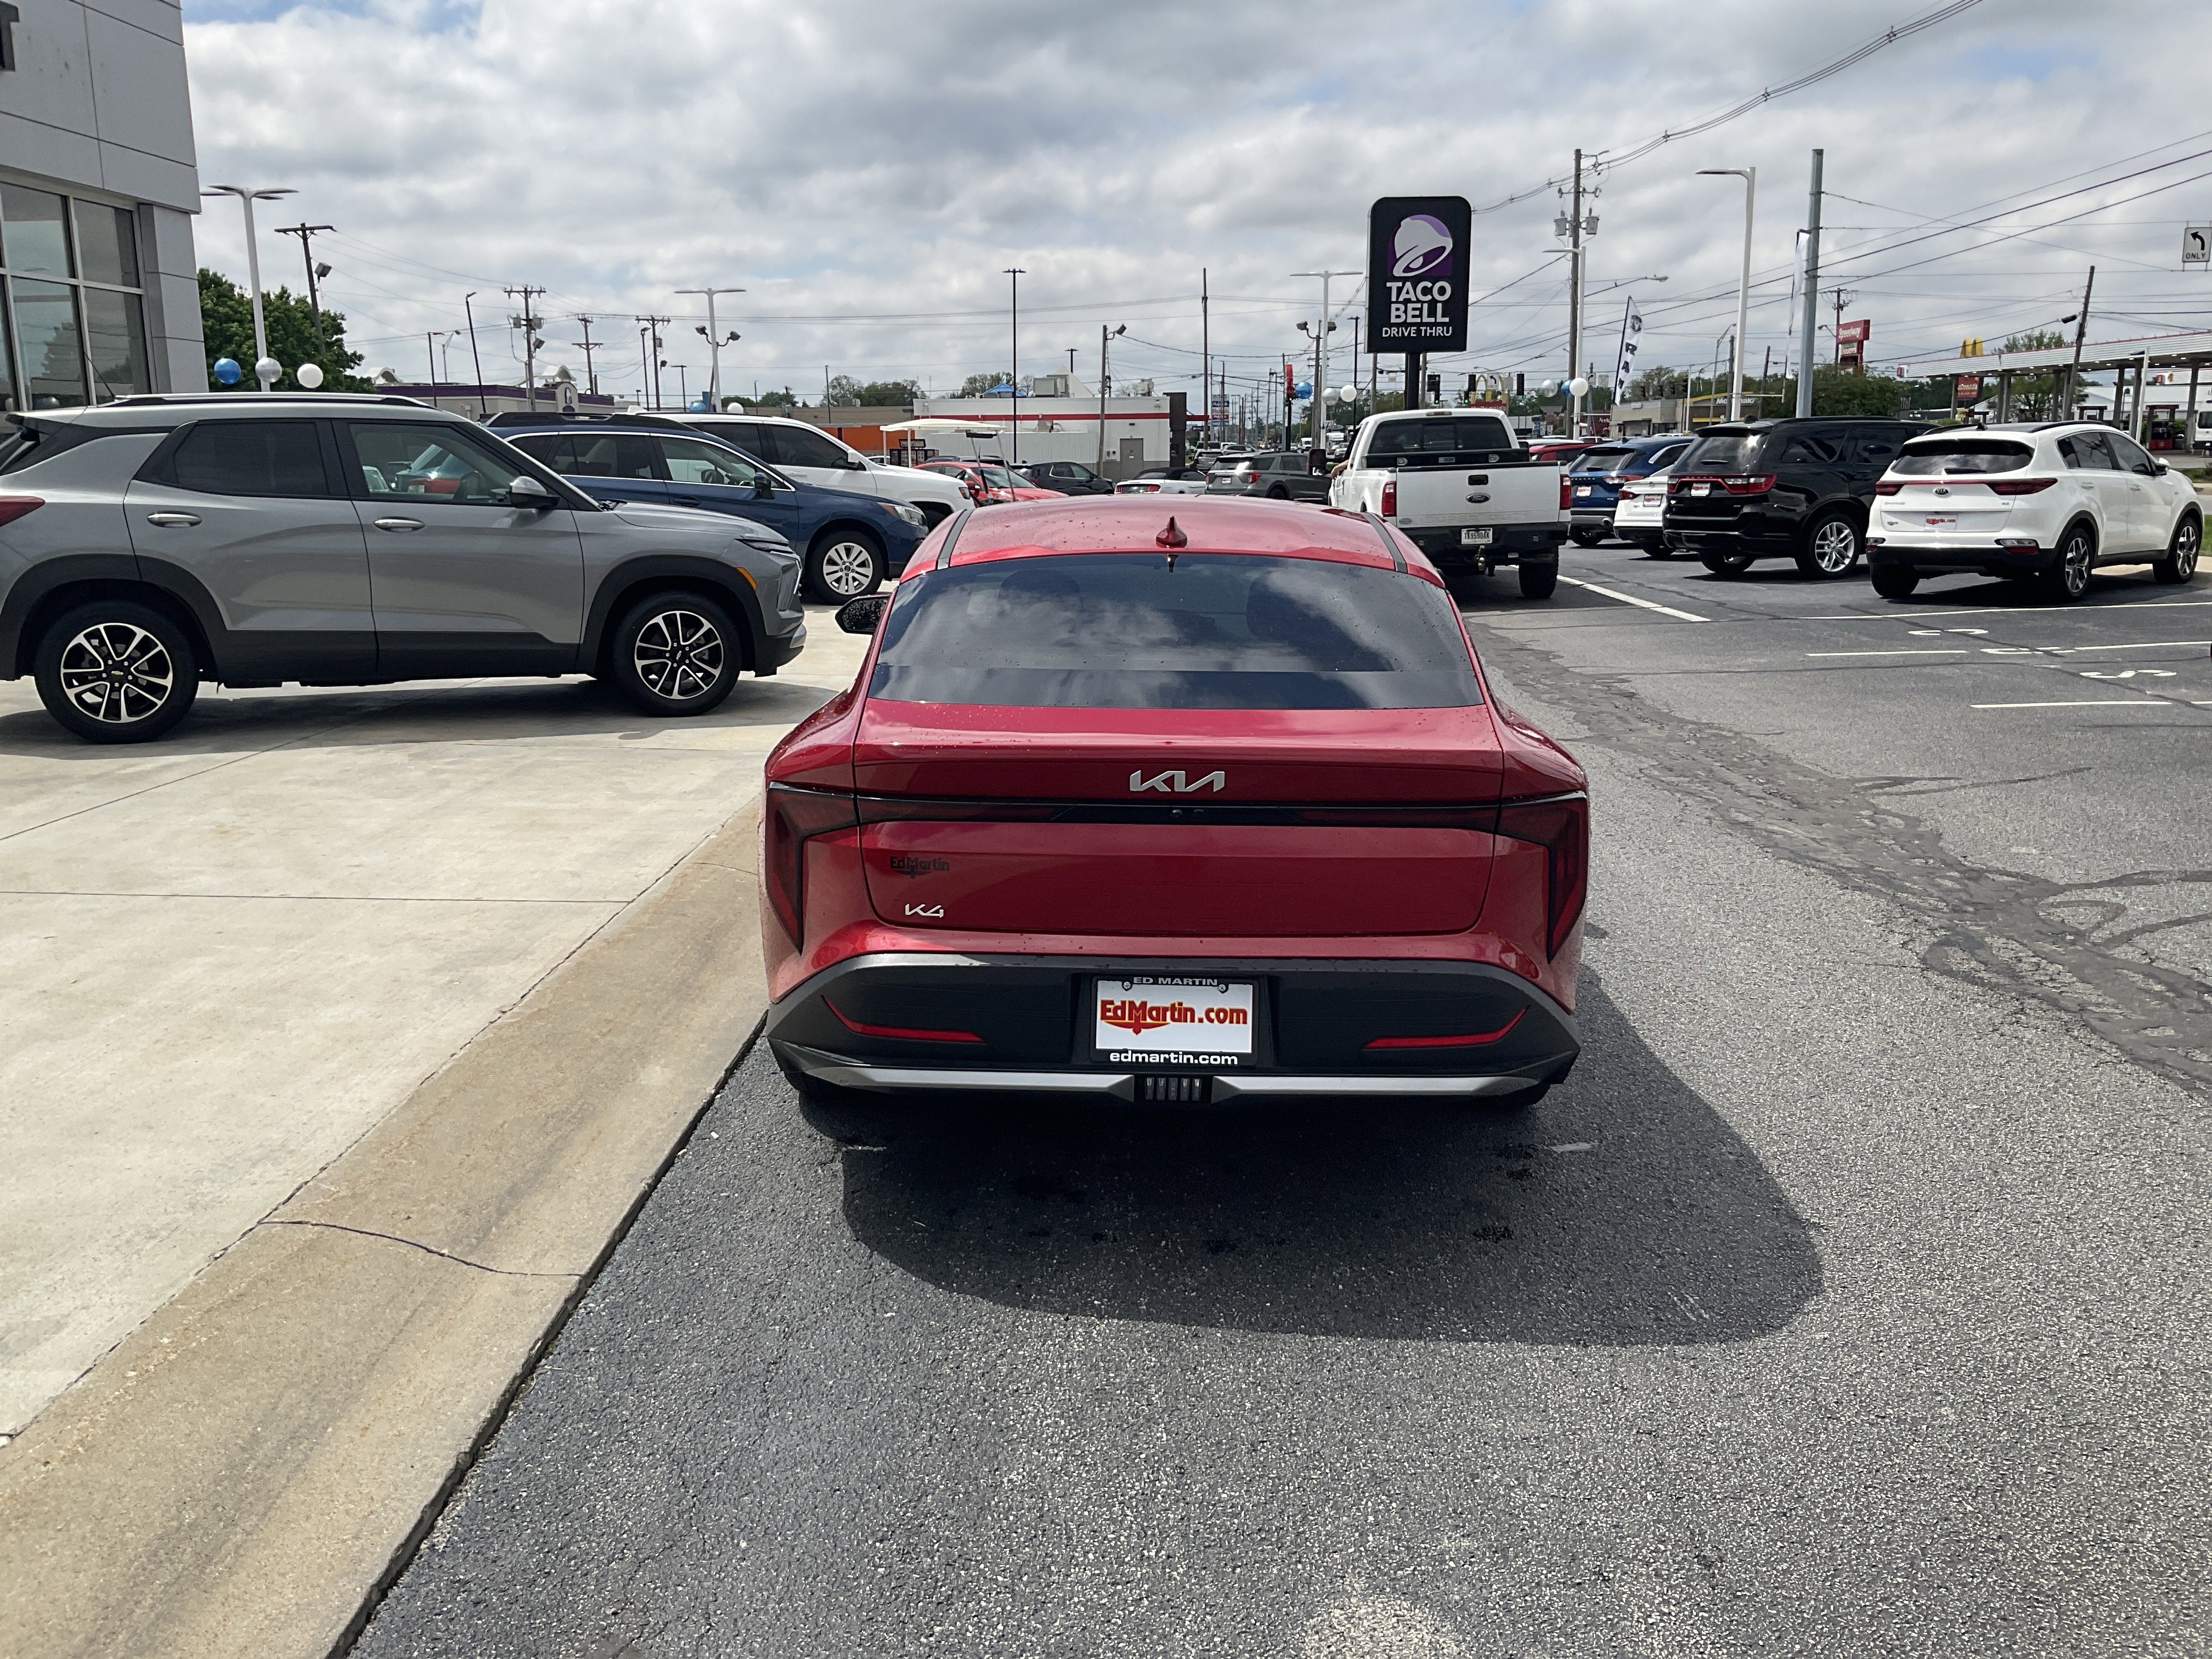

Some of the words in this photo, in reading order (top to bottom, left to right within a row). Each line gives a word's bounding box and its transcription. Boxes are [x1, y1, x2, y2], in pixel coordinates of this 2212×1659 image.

[1386, 281, 1451, 301] TACO
[1391, 303, 1449, 323] BELL
[1383, 327, 1417, 337] DRIVE
[1420, 326, 1452, 336] THRU
[1838, 326, 1861, 341] Speedway
[1130, 770, 1224, 792] KIA
[890, 856, 949, 872] EdMartin
[905, 903, 944, 918] K4
[1101, 999, 1248, 1026] EdMartin.com
[1110, 1051, 1238, 1065] edmartin.com
